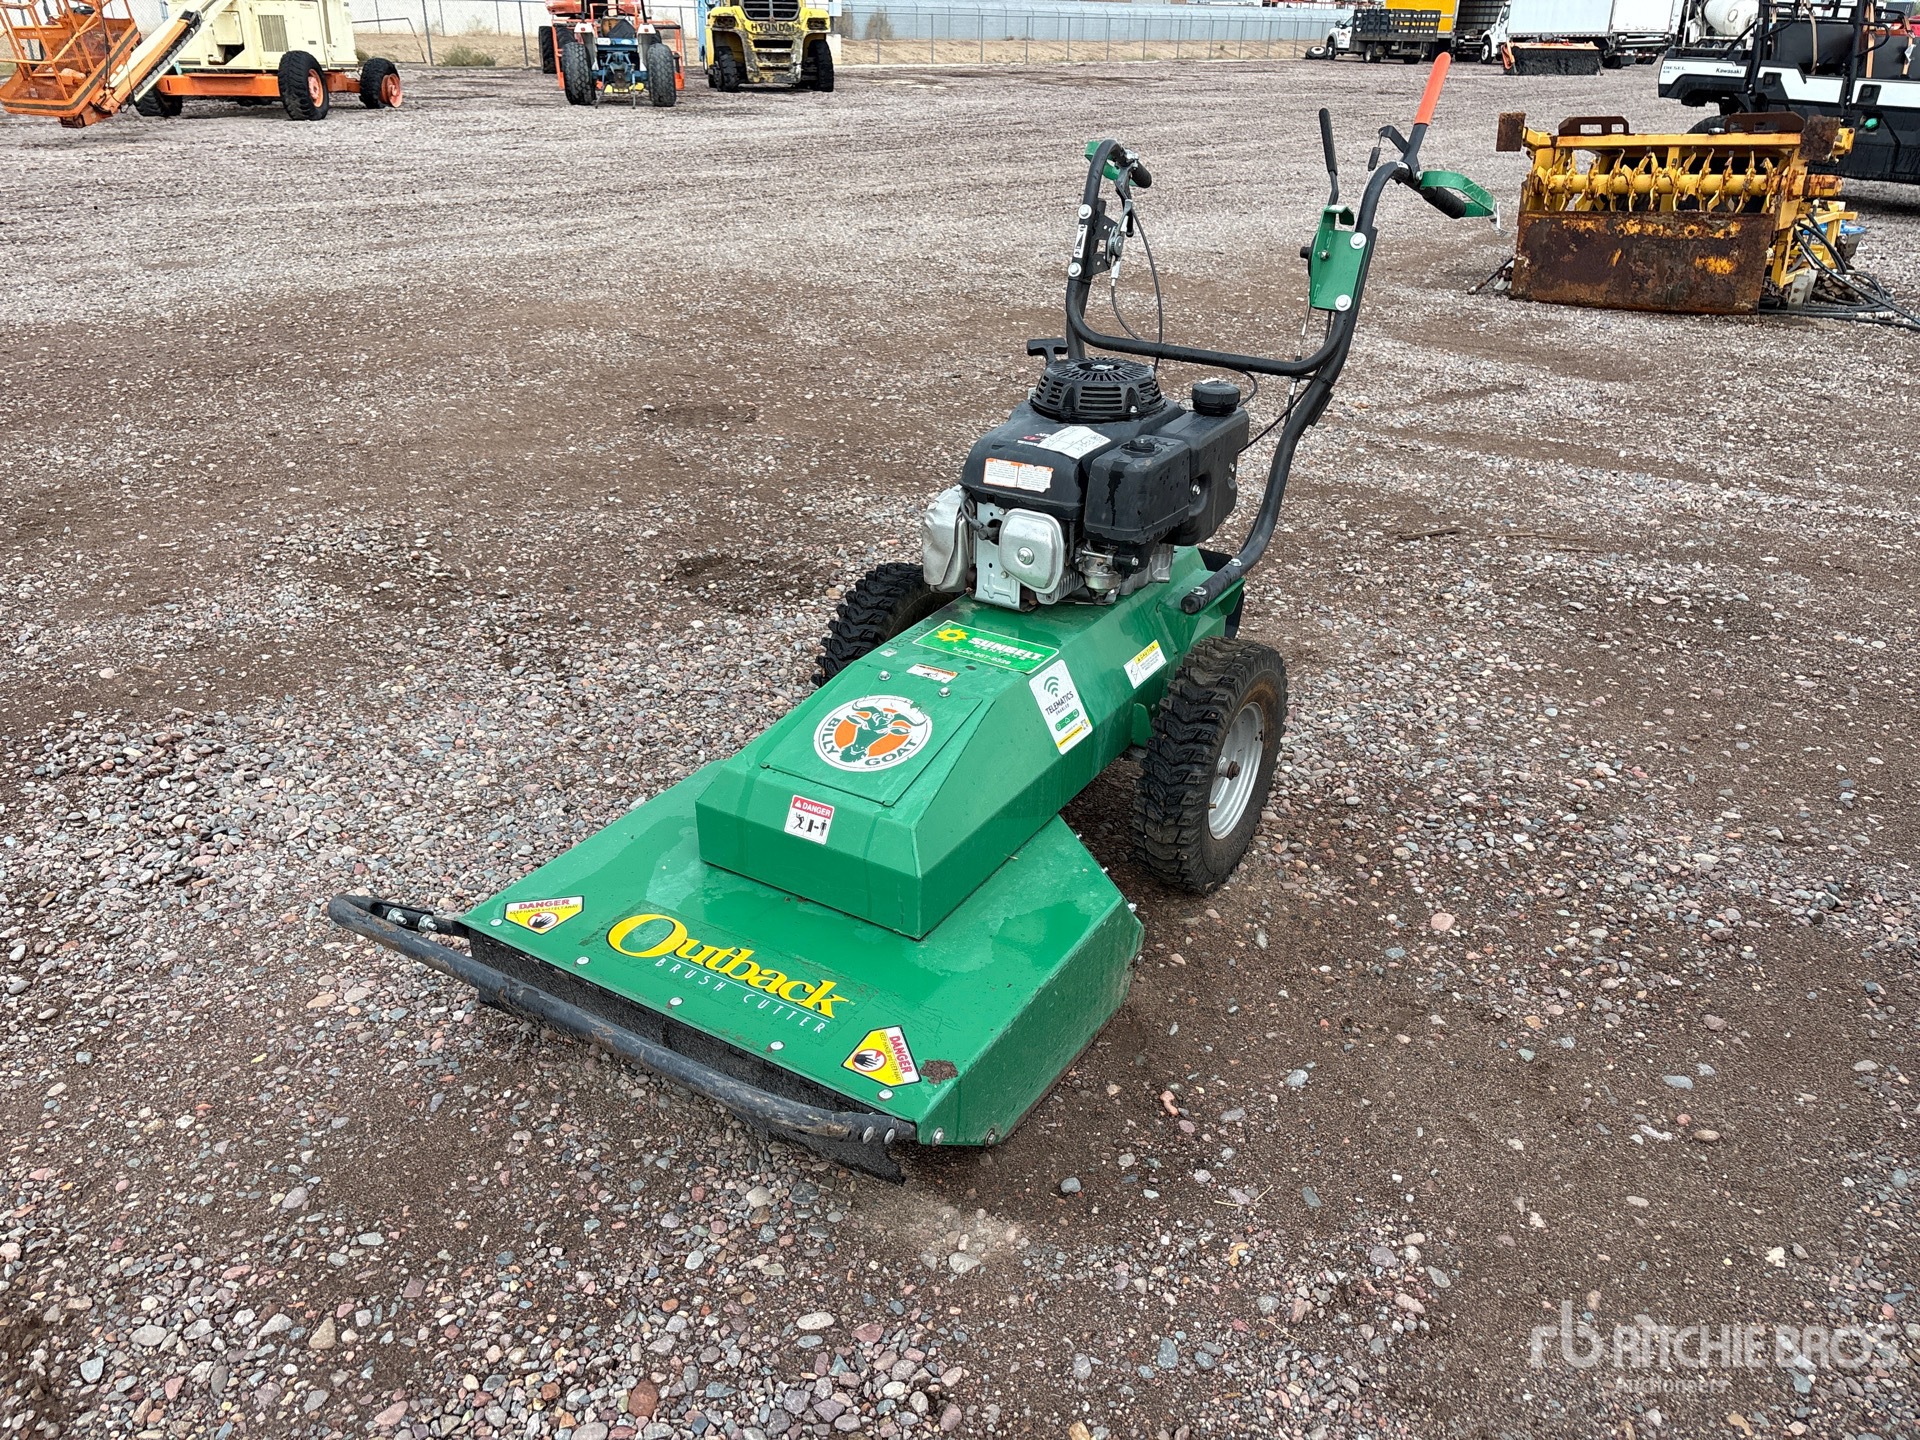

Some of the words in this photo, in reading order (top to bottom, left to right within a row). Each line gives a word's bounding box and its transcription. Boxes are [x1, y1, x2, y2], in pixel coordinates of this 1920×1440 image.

[751, 23, 795, 32] HYUNDAI
[967, 637, 1045, 661] SUNBELT
[1140, 645, 1155, 659] CAUTION
[1045, 690, 1075, 716] TELEMATICS
[821, 717, 842, 755] BILLY
[864, 738, 918, 767] GOAT
[802, 801, 831, 817] DANGER
[518, 899, 570, 910] DANGER
[605, 913, 849, 1019] Outback
[655, 957, 727, 992] BRUSH
[743, 993, 826, 1034] CUTTER
[889, 1035, 913, 1074] DANGER
